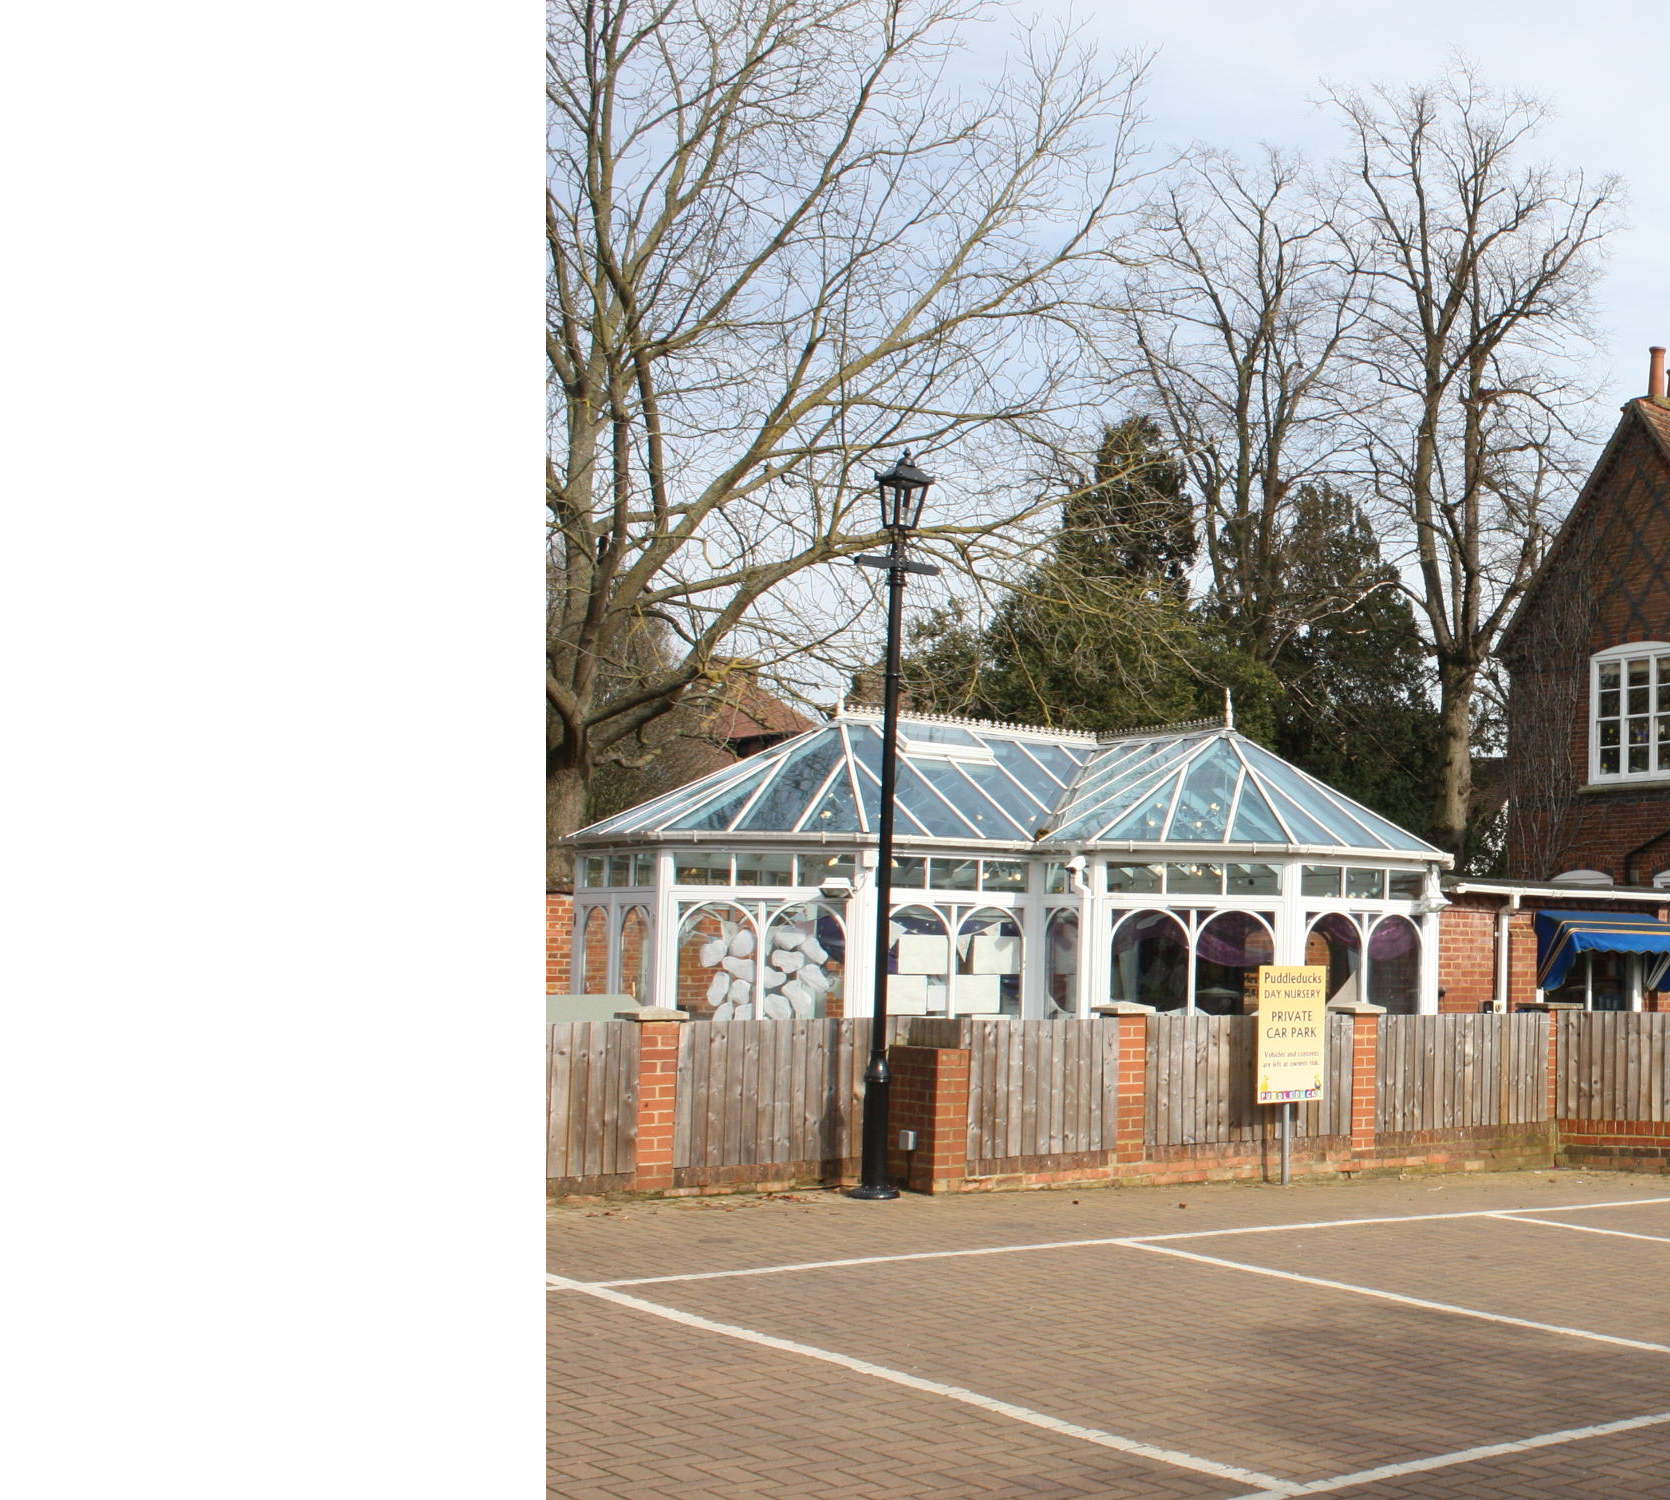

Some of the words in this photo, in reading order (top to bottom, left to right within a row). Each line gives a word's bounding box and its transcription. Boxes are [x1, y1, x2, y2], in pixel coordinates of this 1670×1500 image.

[1264, 972, 1322, 983] Puddleducks
[1264, 989, 1281, 999] DAY
[1284, 989, 1320, 999] NURSERY
[1271, 1010, 1312, 1022] PRIVATE
[1266, 1026, 1287, 1038] CAR
[1291, 1026, 1317, 1038] PARK
